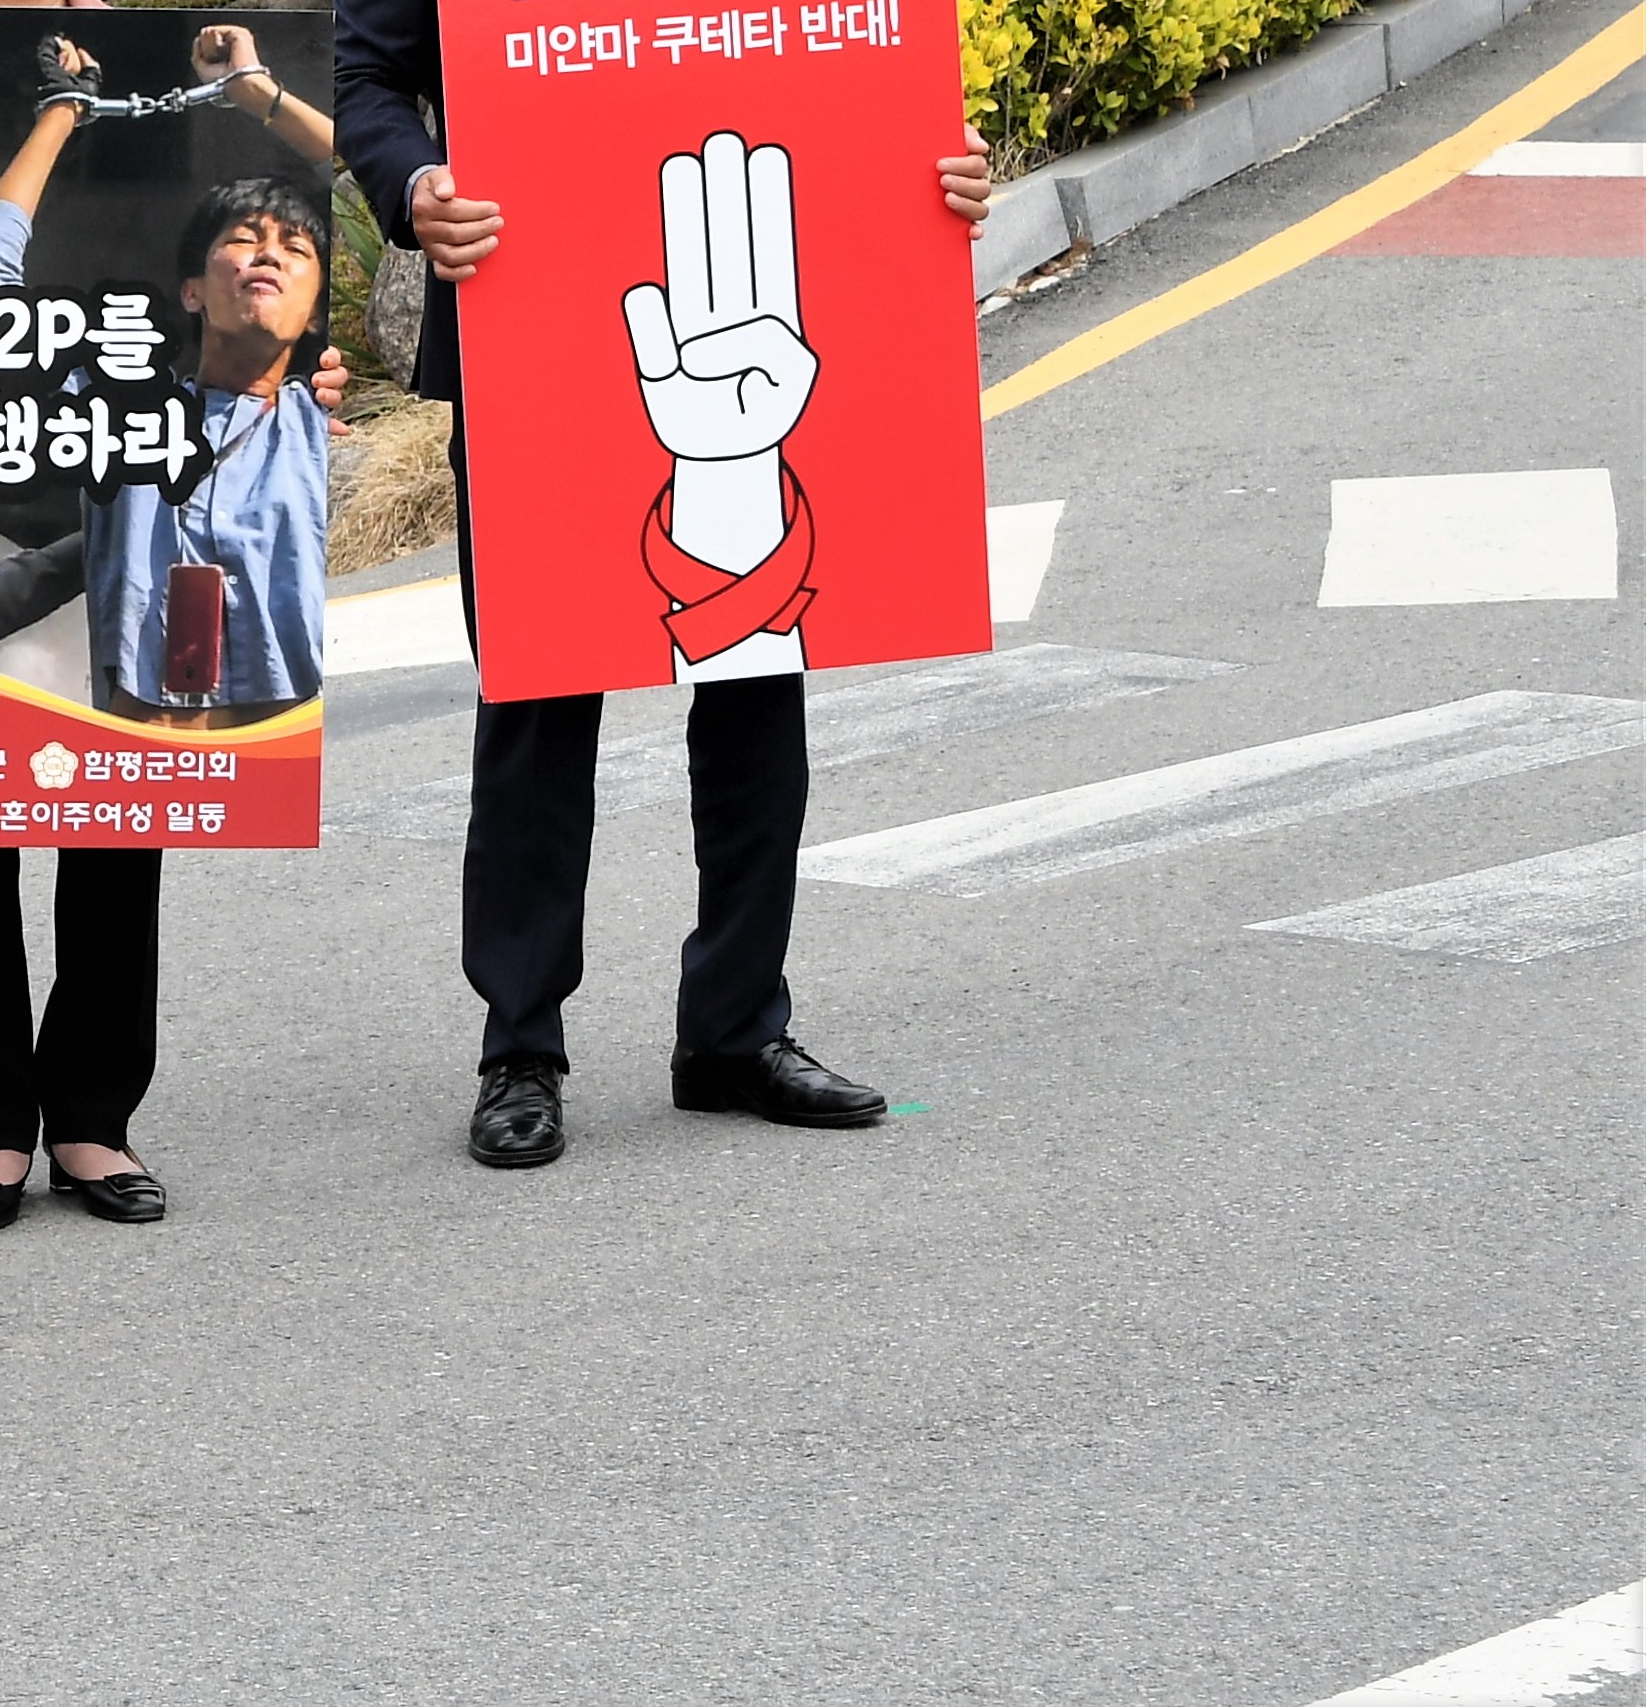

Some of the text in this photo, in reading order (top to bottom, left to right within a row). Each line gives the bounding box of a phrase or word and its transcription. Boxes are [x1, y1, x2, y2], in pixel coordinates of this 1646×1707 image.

[505, 18, 641, 76] 미얀마
[652, 6, 788, 65] 쿠테타
[84, 750, 236, 782] 함평군의회
[166, 802, 226, 834] 일동
